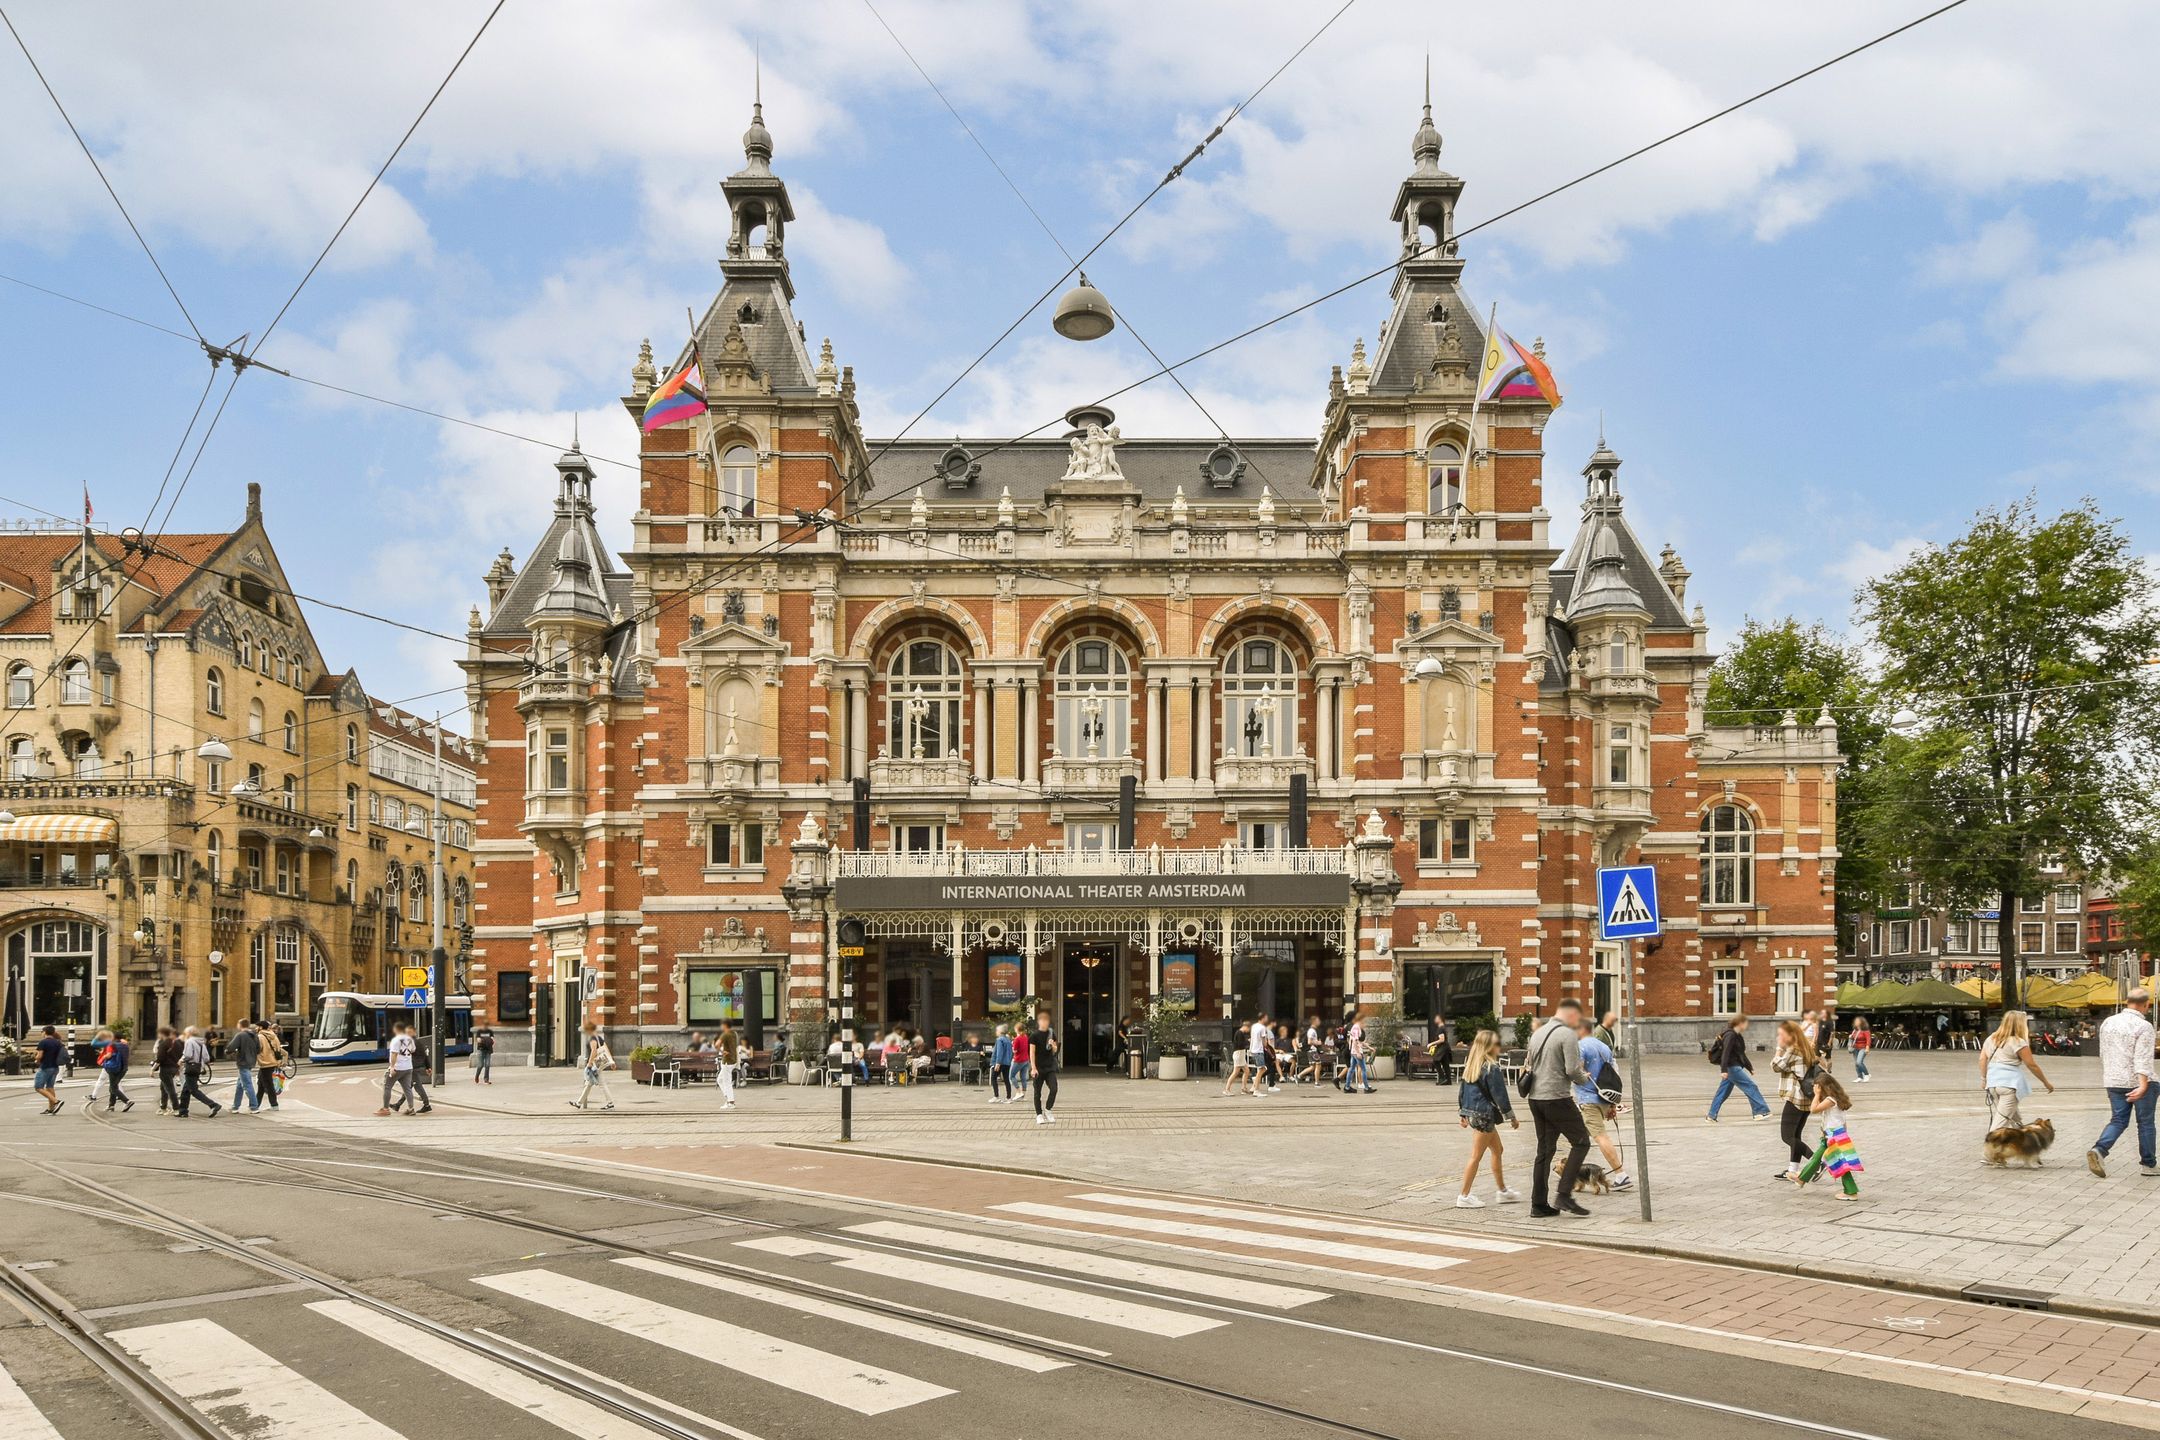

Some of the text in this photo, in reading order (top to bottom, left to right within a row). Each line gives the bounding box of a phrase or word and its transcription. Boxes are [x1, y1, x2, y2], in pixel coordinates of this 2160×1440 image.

[942, 884, 1245, 899] INTERNATIONAAL THEATER AMSTERDAM
